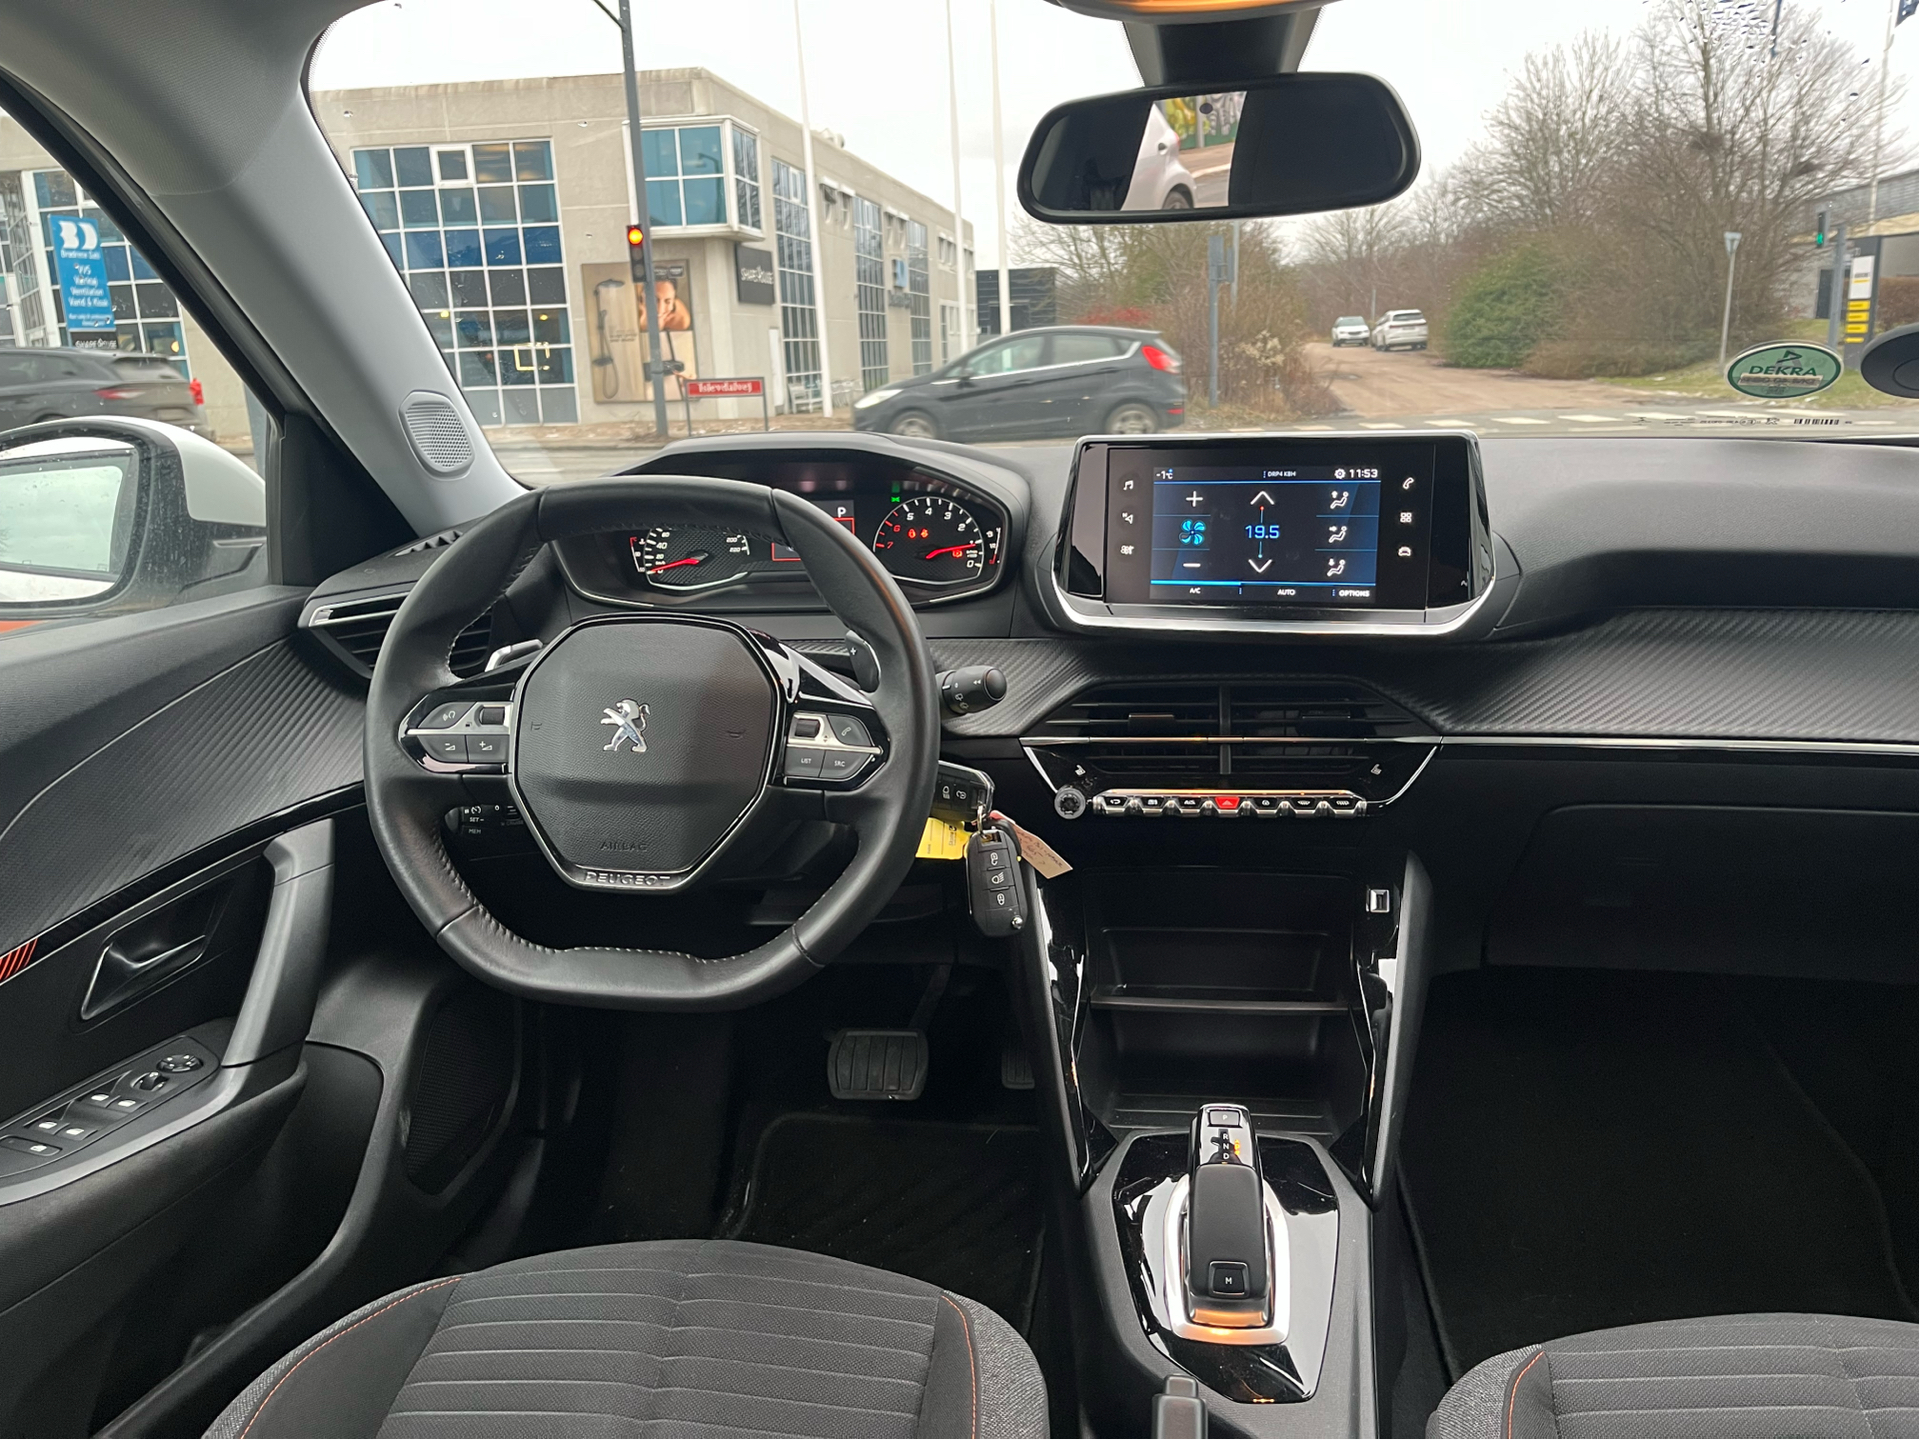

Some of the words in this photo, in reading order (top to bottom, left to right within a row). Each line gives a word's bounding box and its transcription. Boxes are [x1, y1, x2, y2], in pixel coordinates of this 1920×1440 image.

[1748, 365, 1818, 377] DEKRA
[697, 381, 753, 394] Islevdalvej
[1349, 468, 1379, 479] 11:53
[837, 506, 847, 518] P
[925, 507, 933, 516] 4
[944, 511, 952, 521] 3
[906, 512, 914, 521] 5
[893, 524, 901, 533] 6
[957, 523, 966, 532] 2
[1245, 524, 1280, 540] 19.5
[887, 541, 894, 549] 7
[966, 559, 975, 568] 0
[1189, 587, 1201, 595] A/C
[1277, 588, 1296, 596] AUTO
[1338, 589, 1371, 598] OPTIONS
[834, 760, 846, 768] SRC
[600, 841, 648, 852] AIRBAG
[585, 871, 671, 886] PEUGEOT
[1222, 1152, 1230, 1160] D
[1225, 1277, 1233, 1285] M
